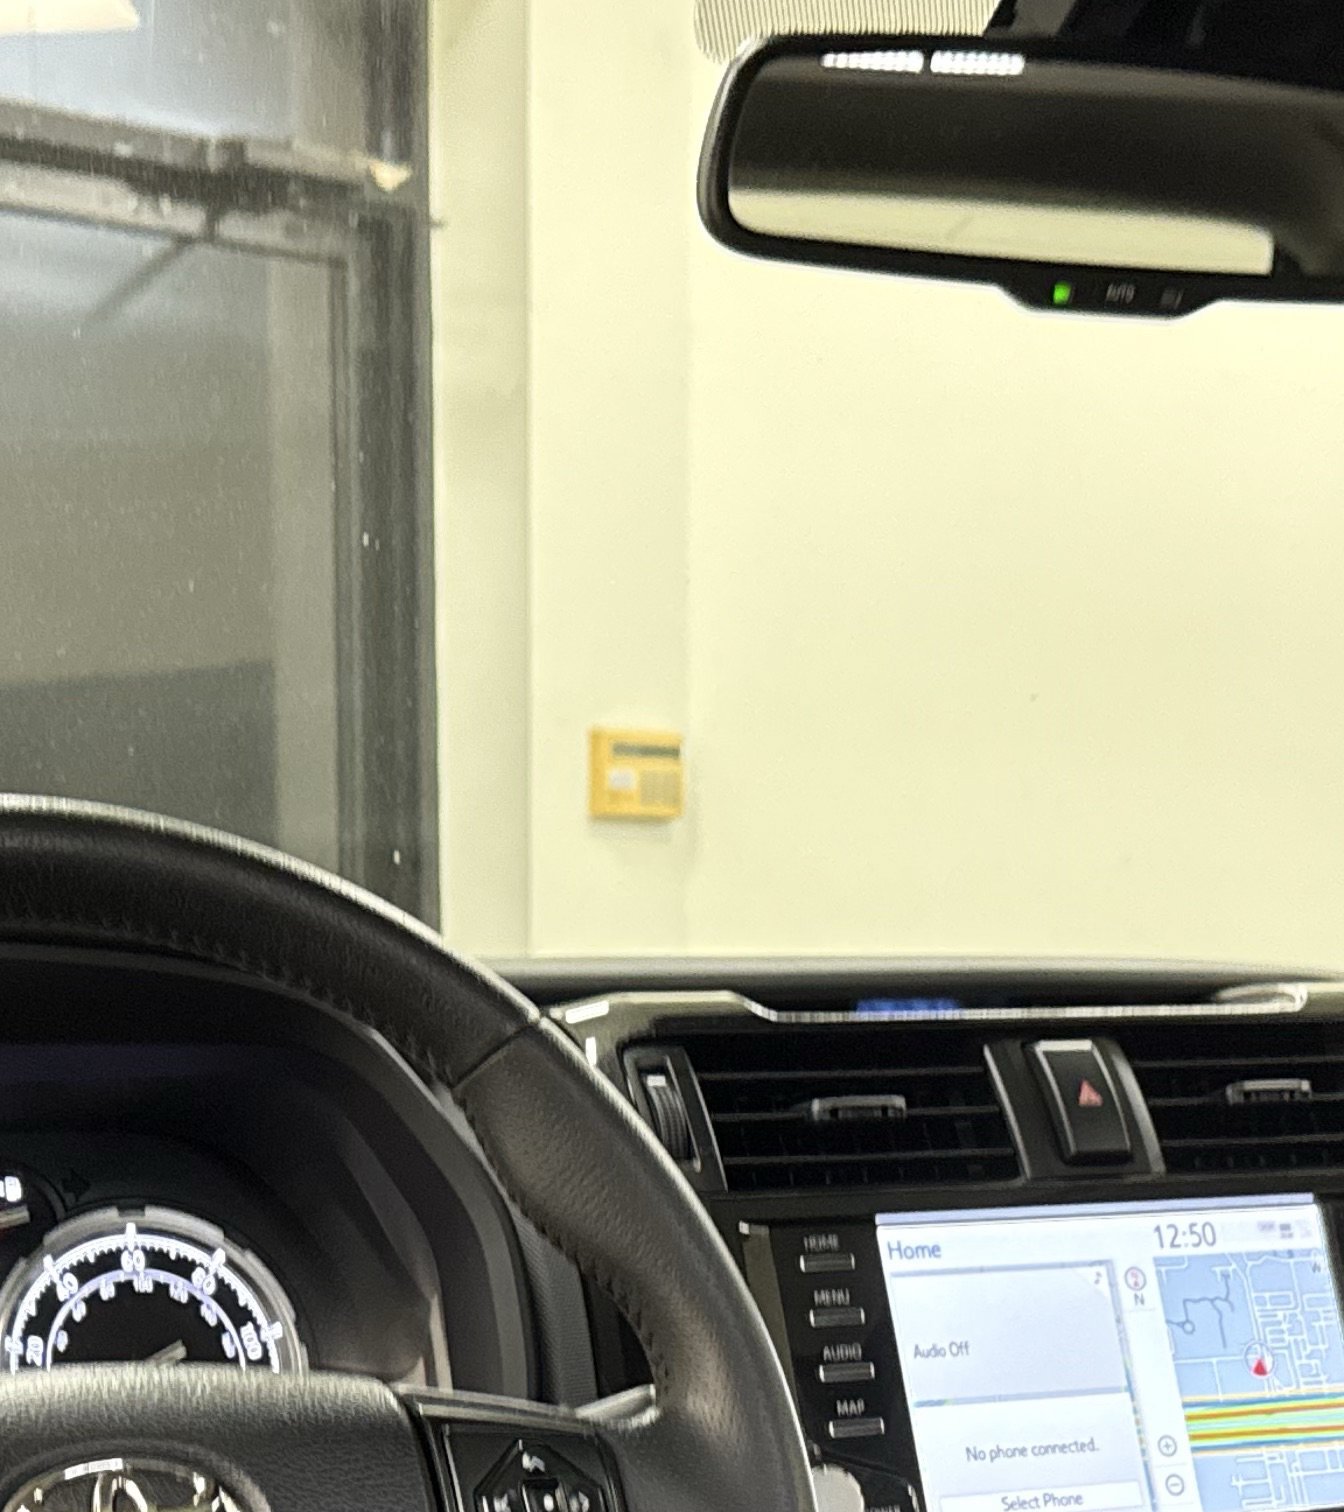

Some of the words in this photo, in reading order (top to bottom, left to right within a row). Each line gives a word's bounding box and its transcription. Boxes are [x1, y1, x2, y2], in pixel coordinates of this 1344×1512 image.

[1153, 1221, 1217, 1249] 12:50
[887, 1241, 942, 1260] Home
[121, 1249, 145, 1272] 60
[813, 1288, 850, 1306] MENU
[1134, 1293, 1145, 1306] N
[823, 1342, 863, 1361] AUDIO
[913, 1344, 946, 1359] Audio
[948, 1341, 970, 1357] Off
[836, 1398, 865, 1416] MAP
[965, 1446, 987, 1462] No
[989, 1445, 1028, 1463] phone
[1031, 1437, 1100, 1457] connected.
[1001, 1496, 1041, 1512] Select
[1043, 1493, 1084, 1508] Phone
